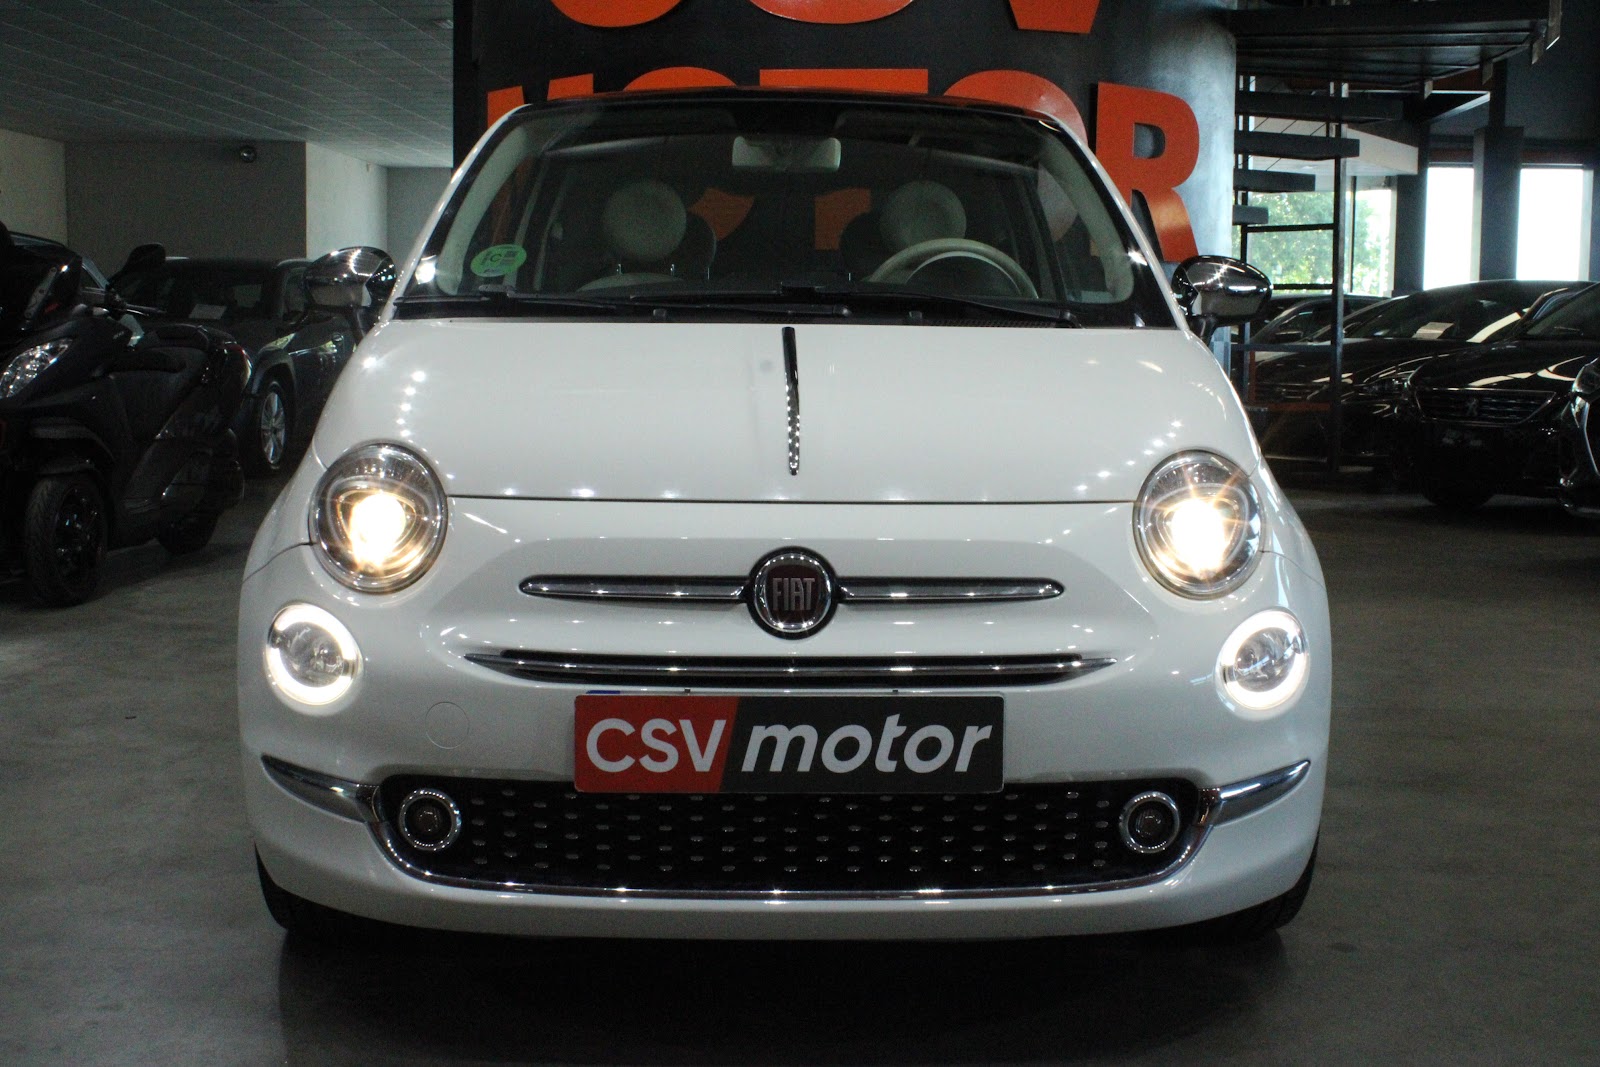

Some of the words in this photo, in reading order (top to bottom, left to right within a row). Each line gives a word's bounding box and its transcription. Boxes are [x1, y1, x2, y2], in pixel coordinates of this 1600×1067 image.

[772, 577, 816, 611] FIAT
[586, 718, 727, 774] CSV
[741, 713, 993, 774] motor
